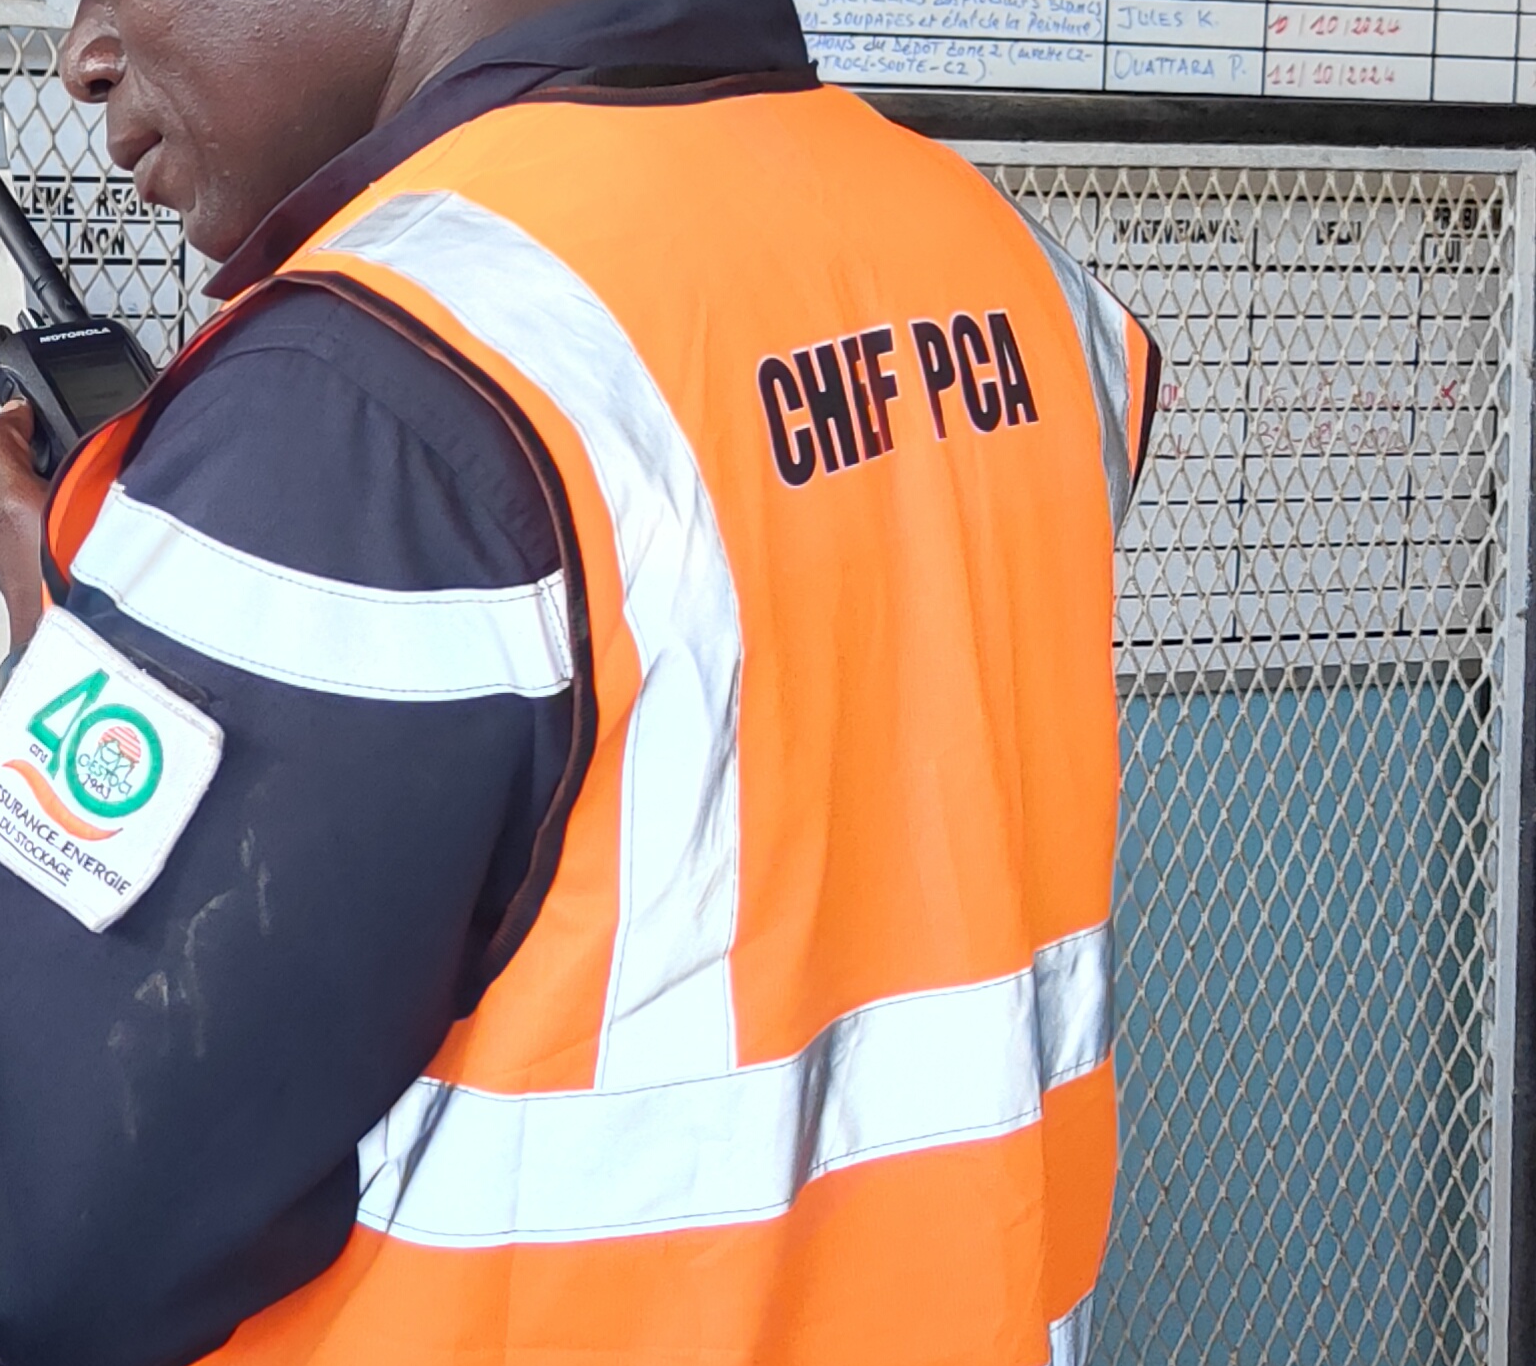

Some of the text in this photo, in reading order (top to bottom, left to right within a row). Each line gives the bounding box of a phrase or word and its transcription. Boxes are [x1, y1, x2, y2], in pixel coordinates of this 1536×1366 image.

[16, 186, 76, 217] LEME
[79, 228, 125, 255] NON
[908, 309, 1040, 440] PCA
[25, 668, 164, 819] 40
[14, 830, 74, 883] STOCKAGE
[59, 839, 132, 897] ENERGIE
